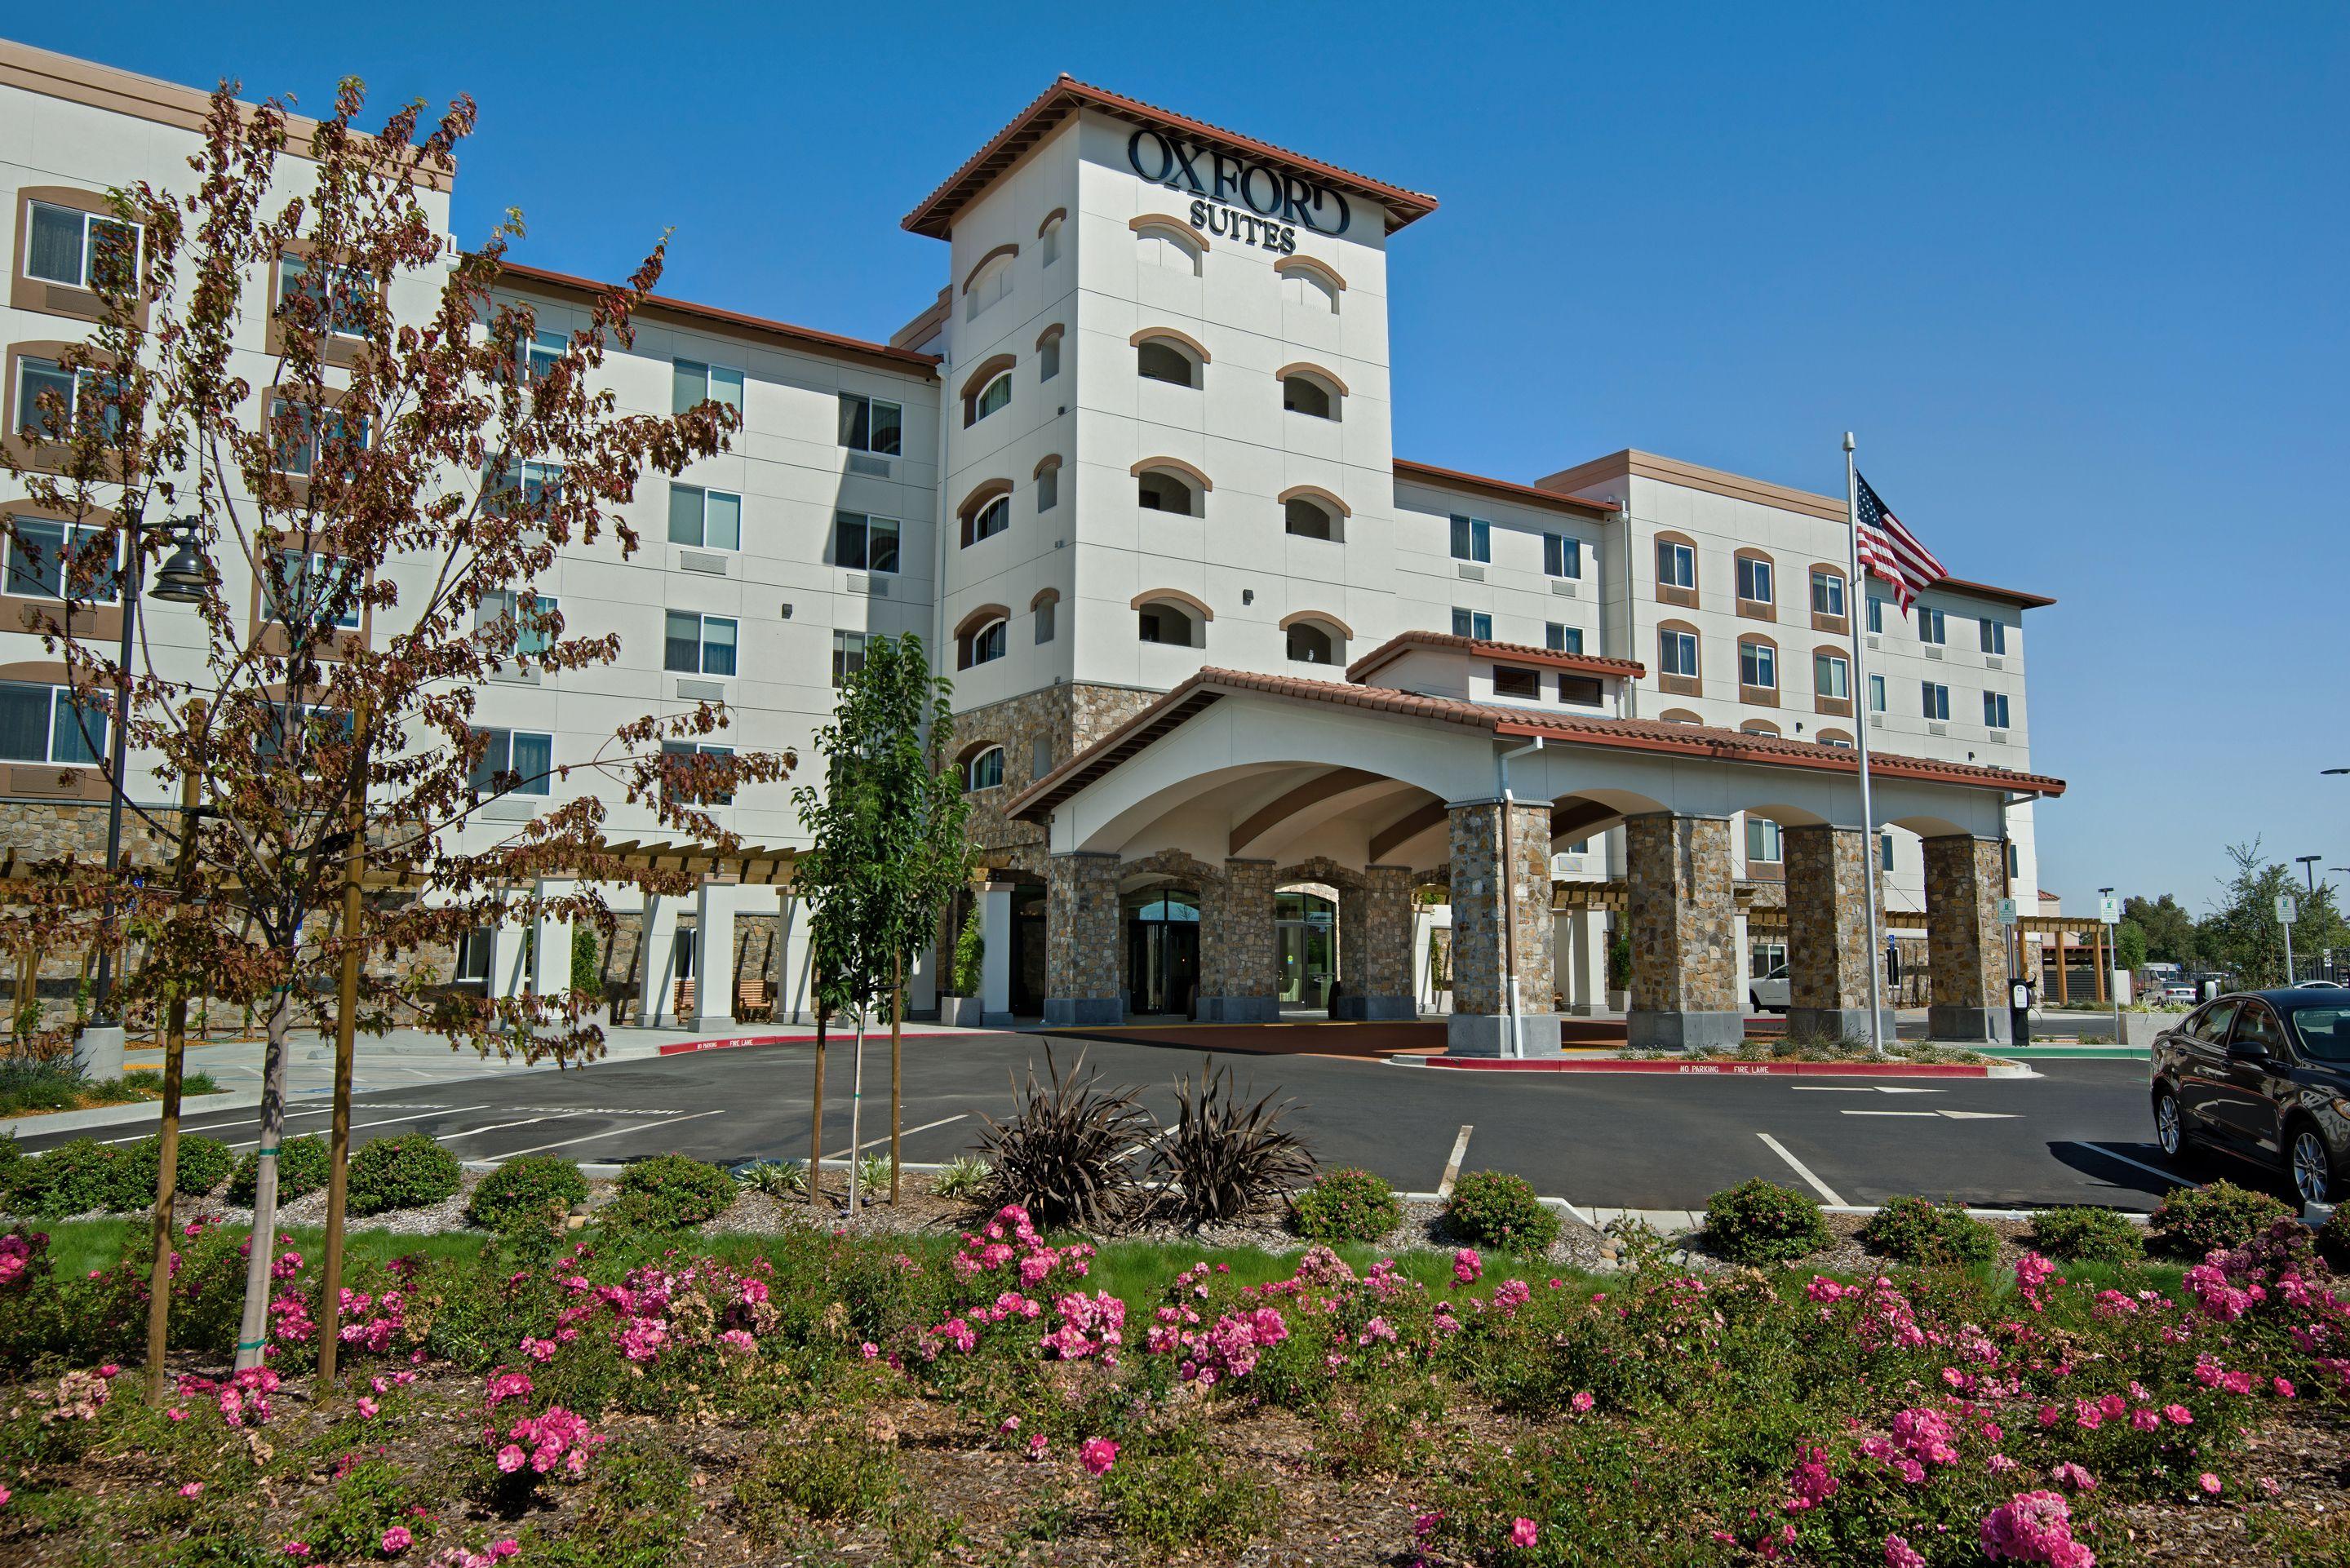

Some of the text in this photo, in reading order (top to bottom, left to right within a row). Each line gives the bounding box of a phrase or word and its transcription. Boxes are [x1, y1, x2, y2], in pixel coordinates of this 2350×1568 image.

[1128, 129, 1350, 235] OXFORD
[1190, 199, 1297, 255] SUITES
[1680, 1065, 1769, 1074] NO PARKING FIRE LANE
